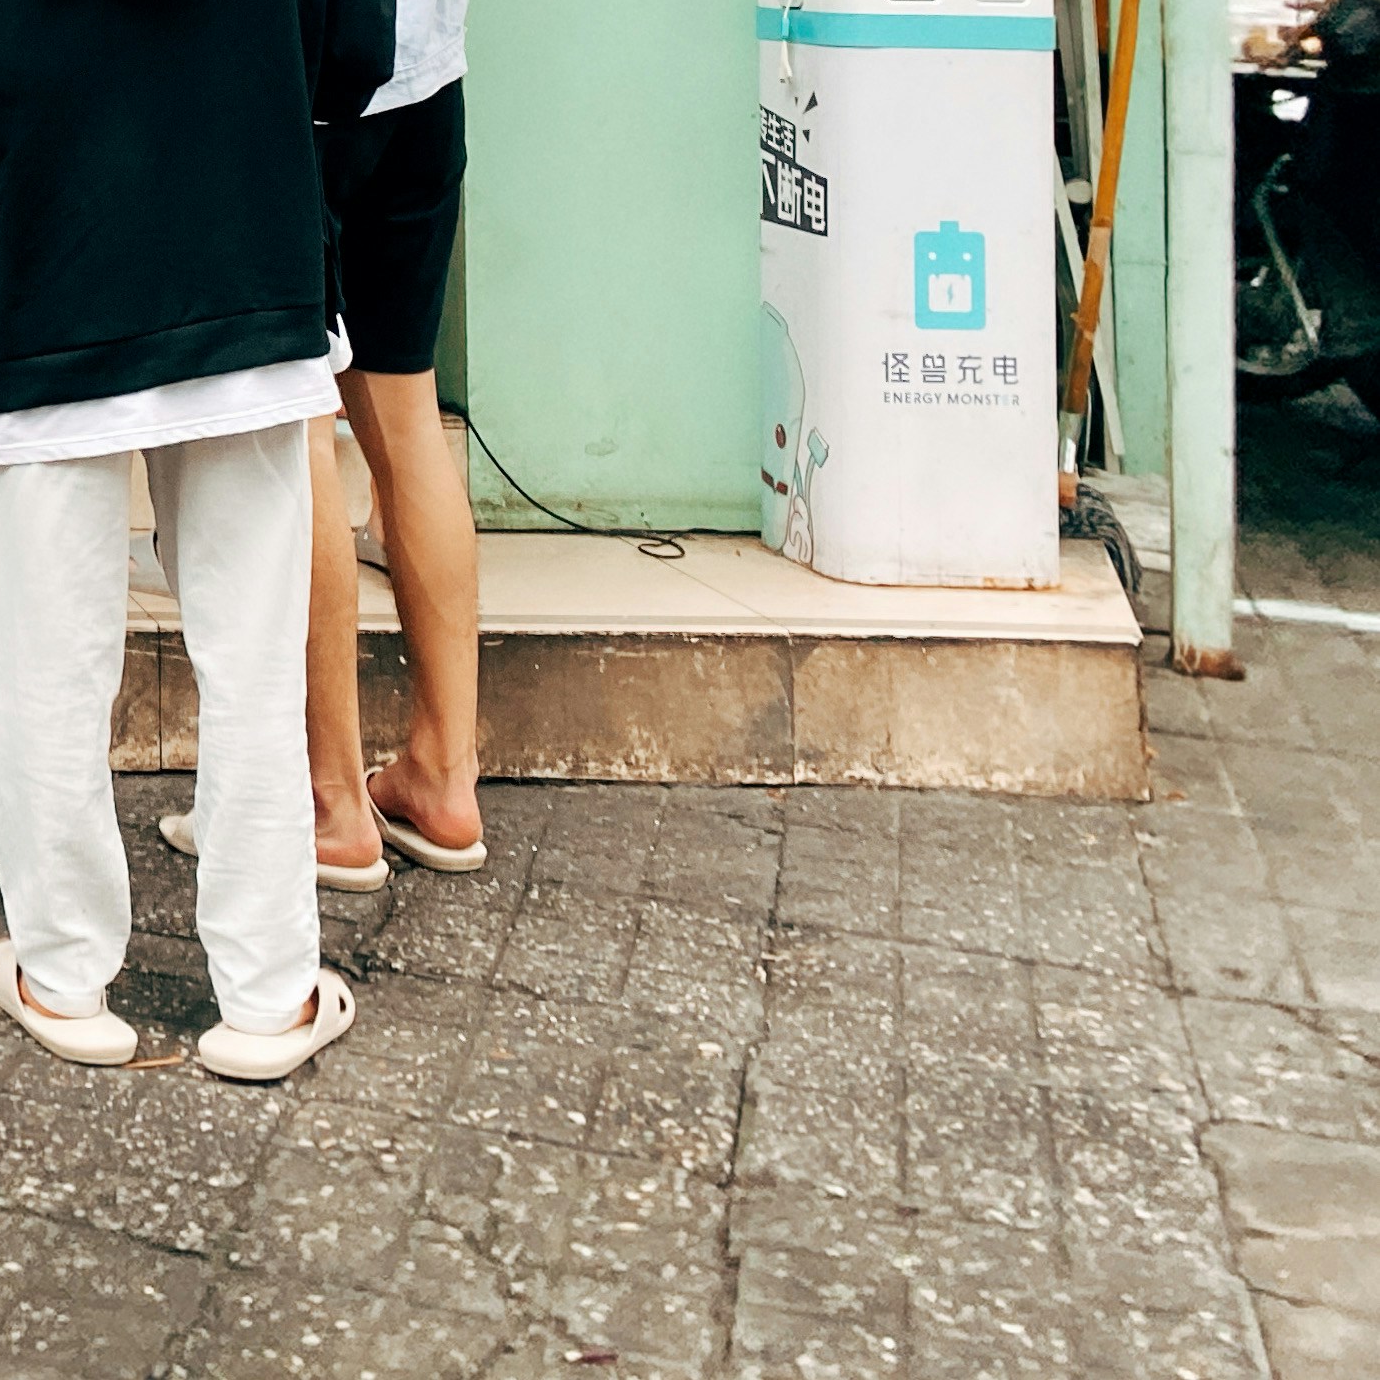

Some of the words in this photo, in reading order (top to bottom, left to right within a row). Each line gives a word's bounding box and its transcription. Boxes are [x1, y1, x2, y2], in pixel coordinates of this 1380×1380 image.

[881, 351, 1020, 386] 怪兽充电
[883, 391, 942, 405] ENERGY
[946, 392, 1020, 407] MONSTR
